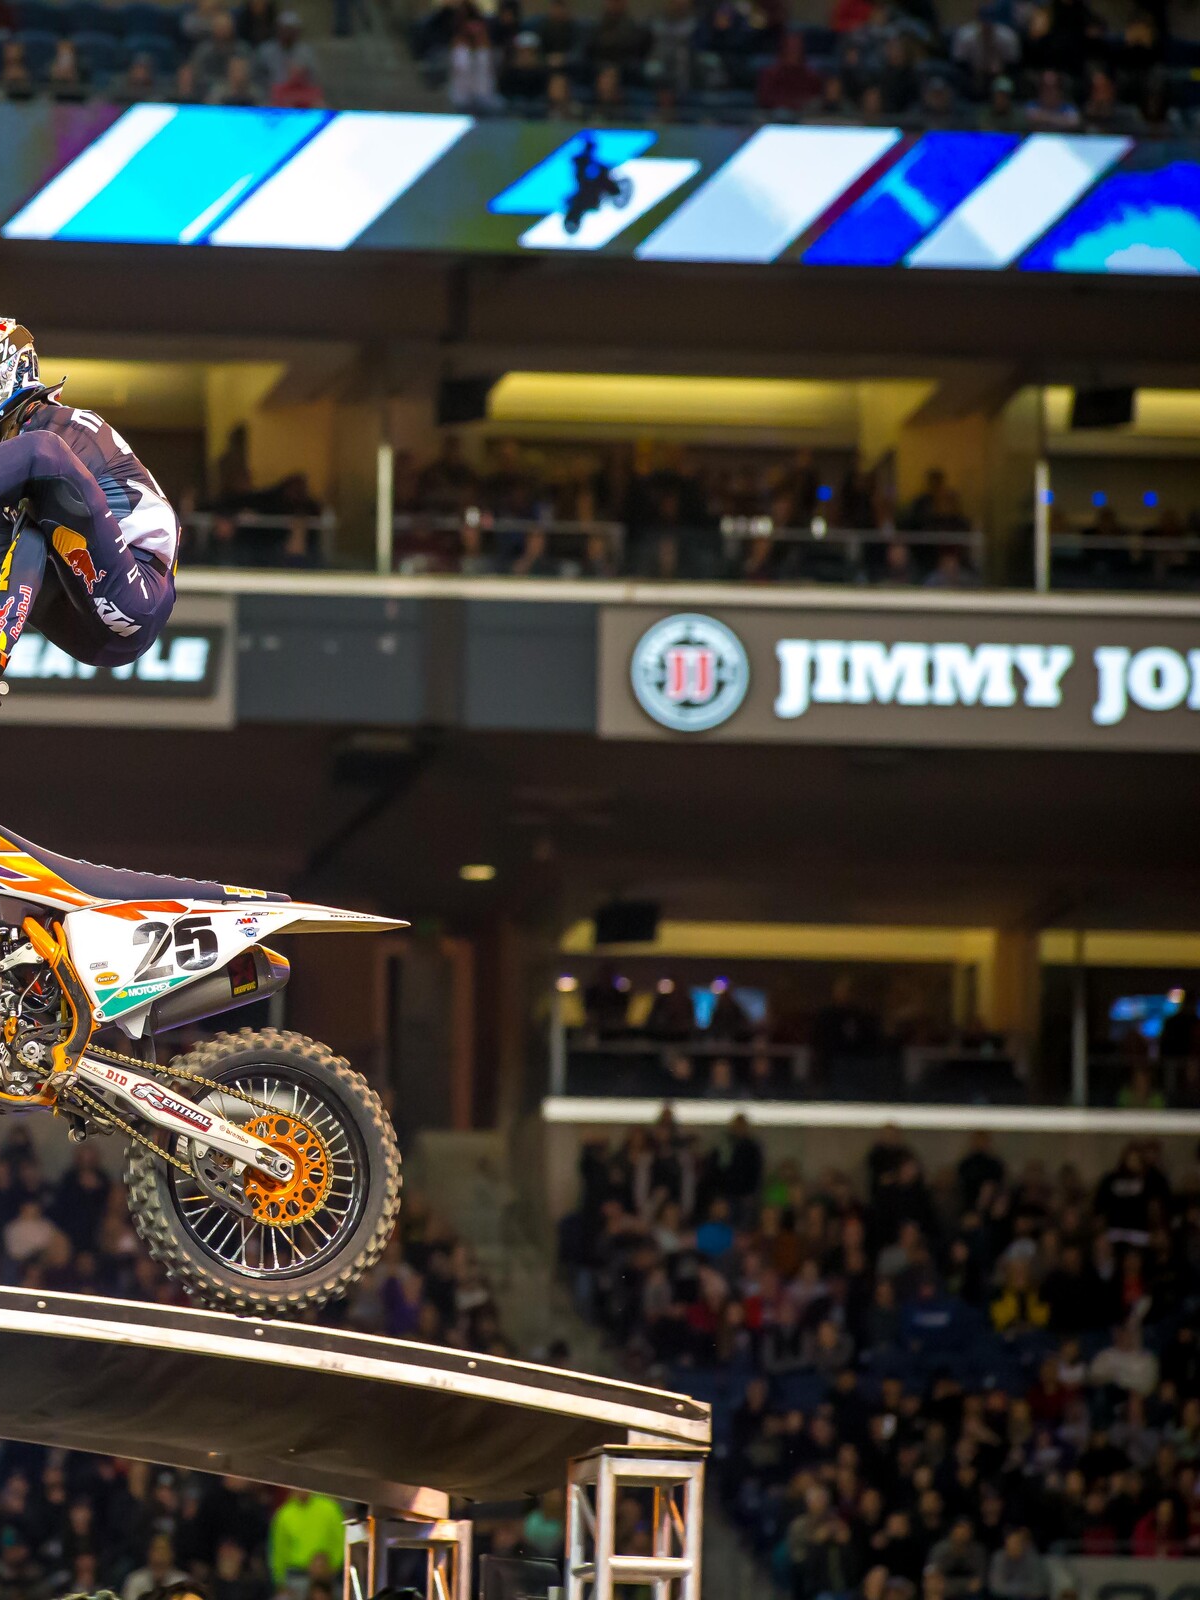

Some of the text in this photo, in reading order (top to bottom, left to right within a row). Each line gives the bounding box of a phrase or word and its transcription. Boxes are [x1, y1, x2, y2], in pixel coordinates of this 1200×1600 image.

[16, 584, 33, 613] Bull
[93, 596, 143, 638] KTM
[774, 638, 1074, 720] JIMMY
[1091, 645, 1200, 727] JO
[235, 917, 258, 926] AMA
[132, 916, 219, 983] 25
[128, 981, 172, 997] MOTOREX
[225, 1128, 249, 1144] brembo
